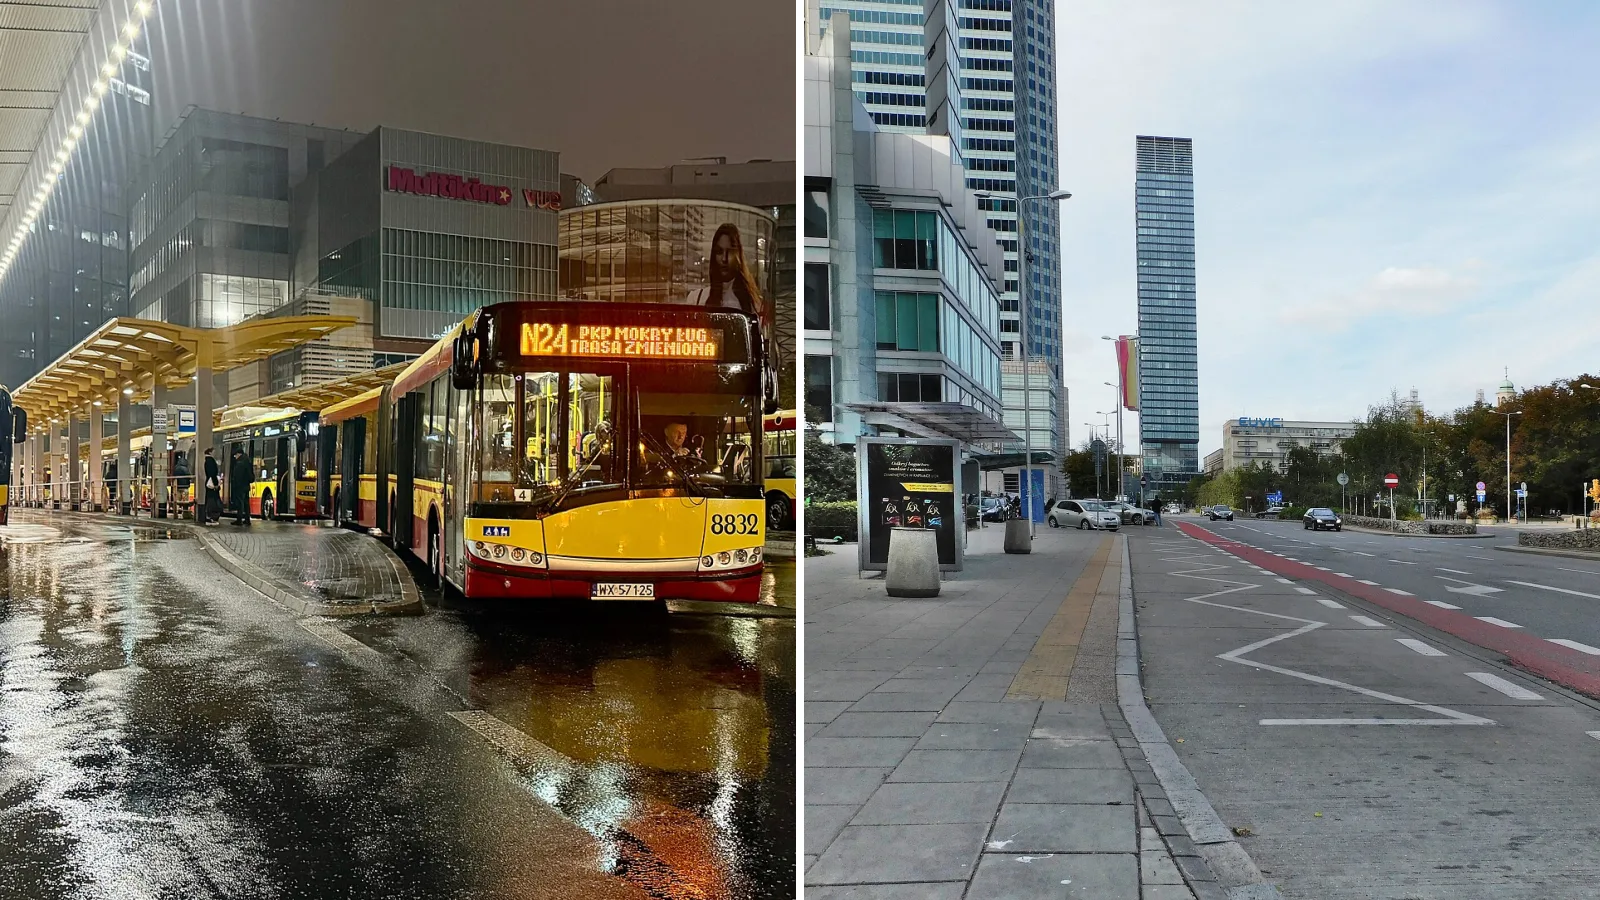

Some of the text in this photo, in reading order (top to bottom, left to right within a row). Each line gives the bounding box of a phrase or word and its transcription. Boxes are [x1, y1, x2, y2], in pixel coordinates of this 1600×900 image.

[389, 165, 512, 206] Multikino
[521, 323, 568, 354] N24
[579, 326, 611, 340] PKP
[614, 327, 672, 342] MOKRY
[570, 340, 716, 357] TRASA ZMIENIONA
[518, 490, 527, 501] 4
[711, 513, 759, 535] 8832
[599, 584, 653, 596] WX 57125
